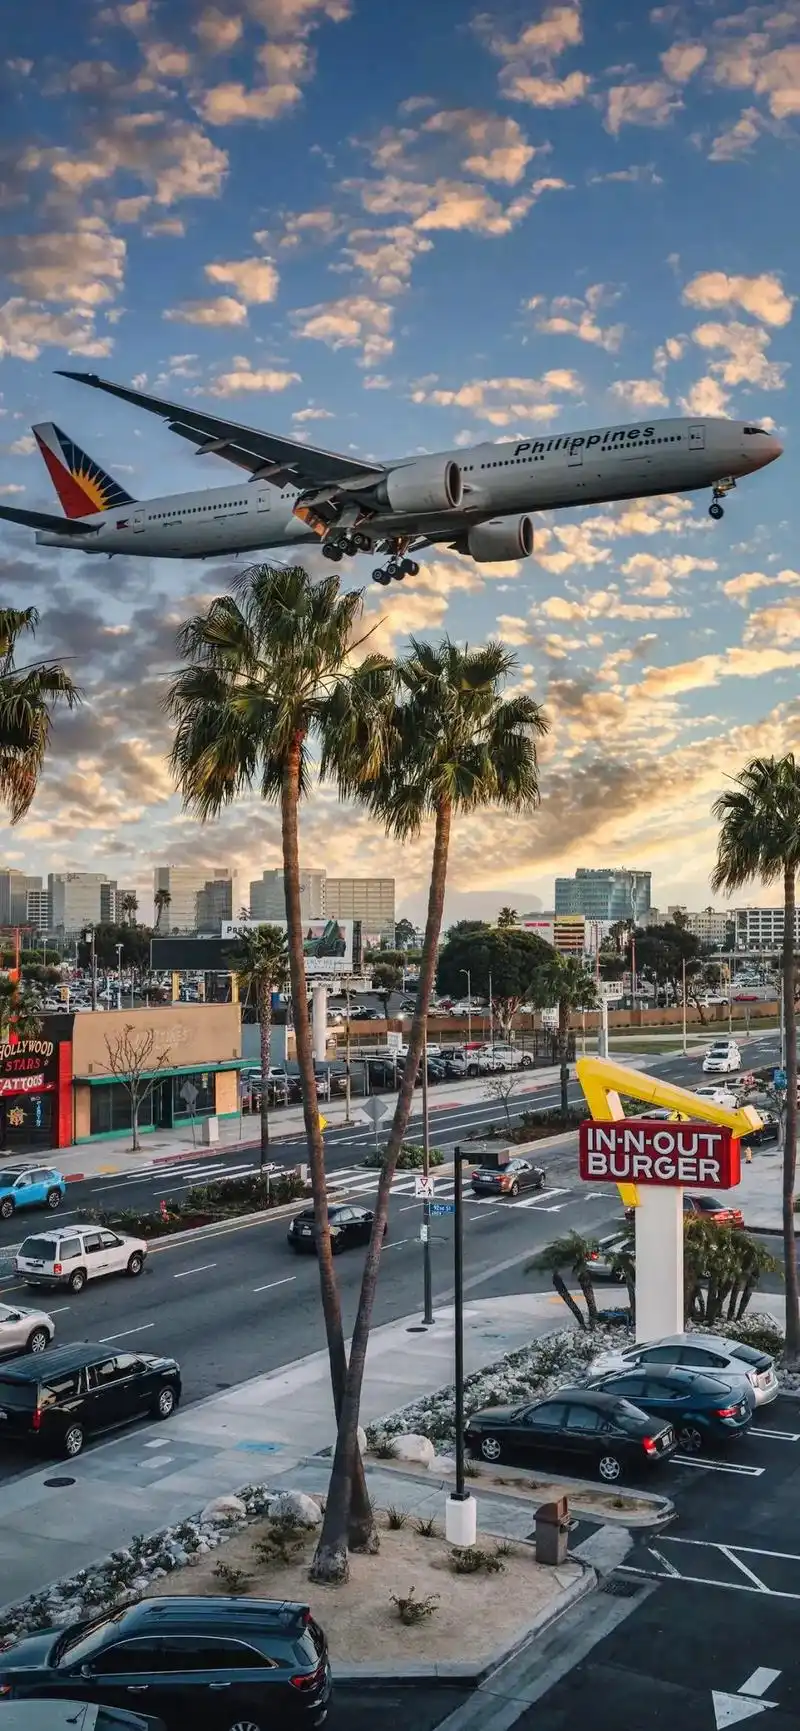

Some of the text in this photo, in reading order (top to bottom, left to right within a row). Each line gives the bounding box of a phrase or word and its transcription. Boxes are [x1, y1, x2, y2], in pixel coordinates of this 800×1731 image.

[514, 427, 655, 456] Philippines
[0, 1040, 54, 1060] HOLLYWOOD
[5, 1058, 41, 1072] STARS
[587, 1128, 722, 1157] IN-N-OUT
[587, 1152, 721, 1183] BURGER
